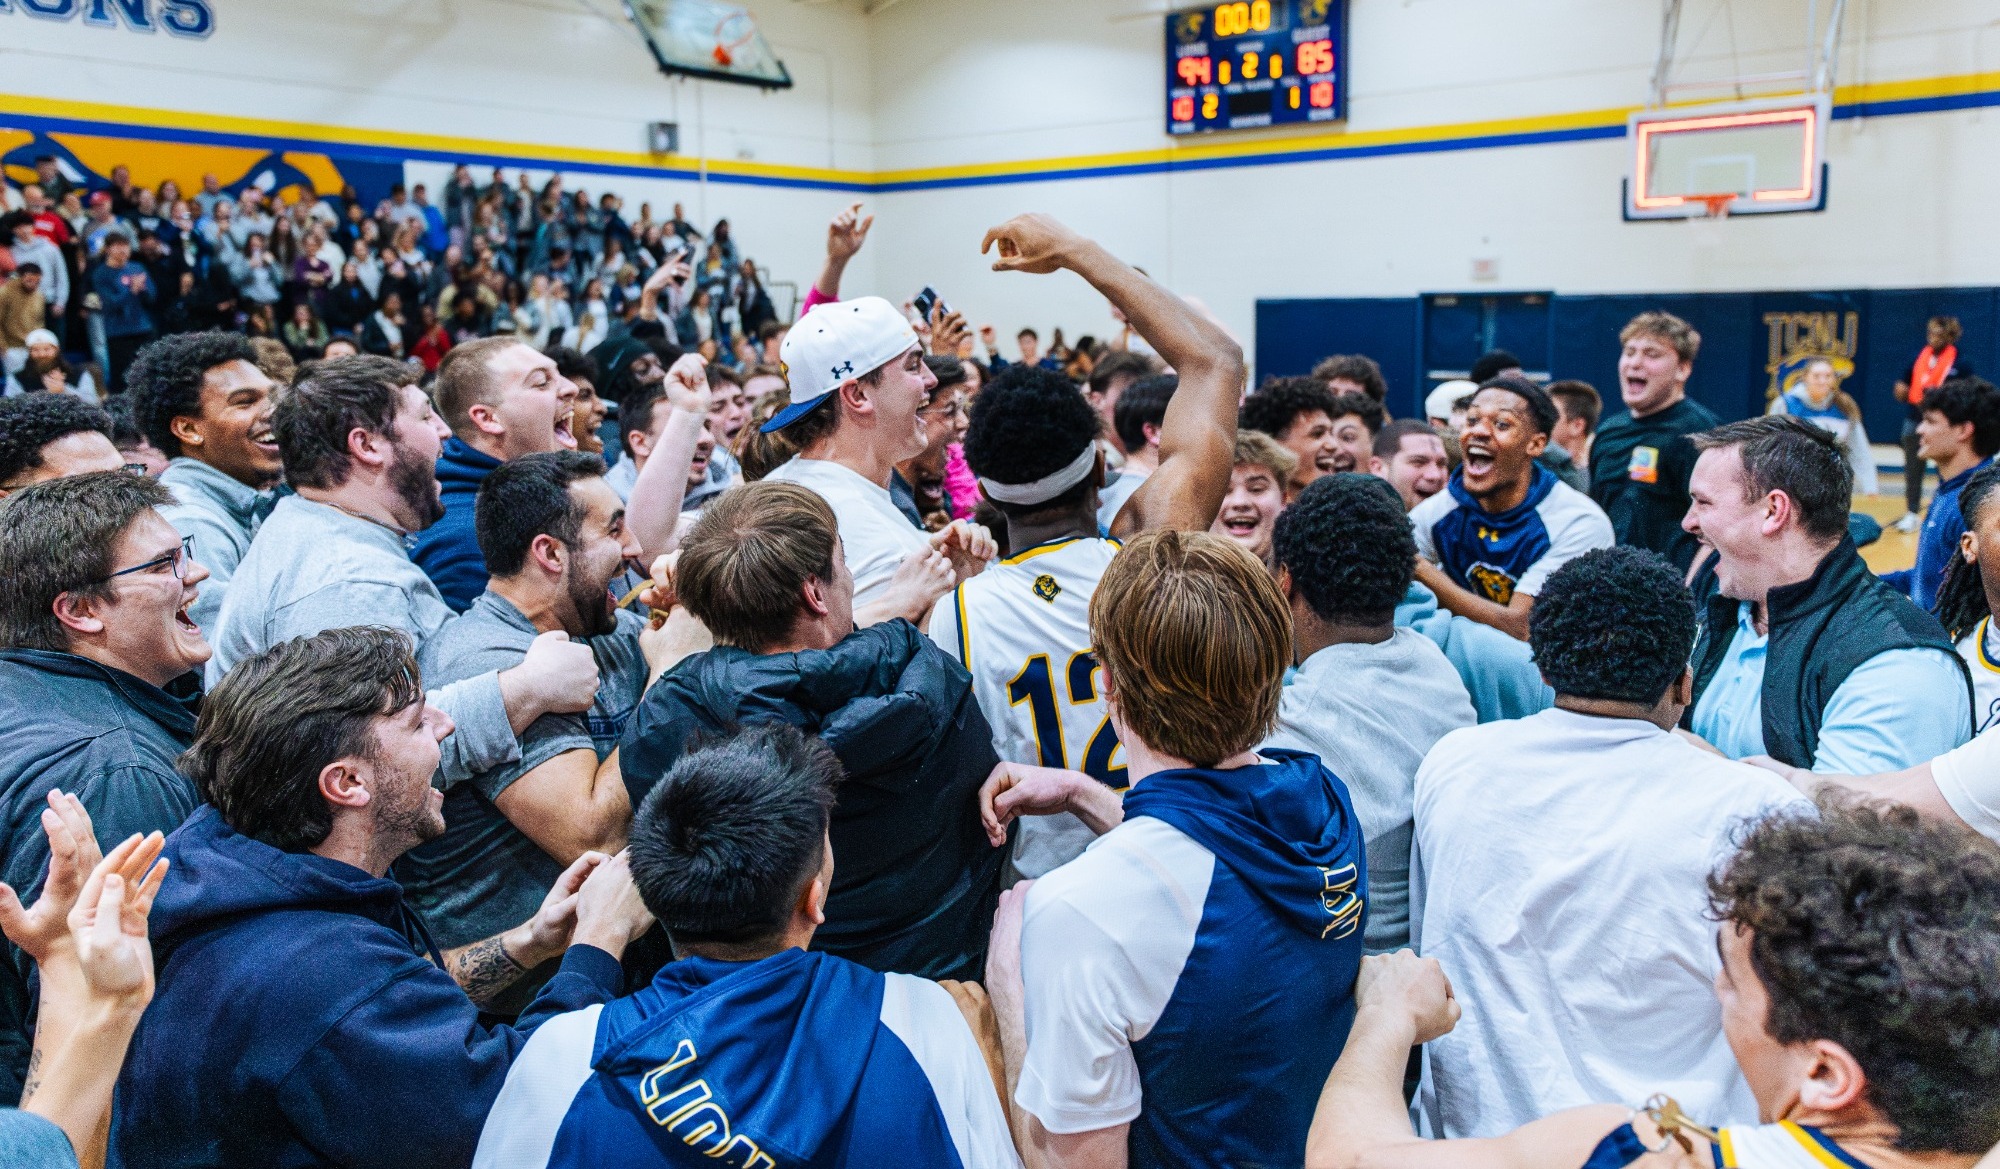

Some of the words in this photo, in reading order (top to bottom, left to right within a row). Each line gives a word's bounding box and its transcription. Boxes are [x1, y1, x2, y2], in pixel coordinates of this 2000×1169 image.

[1177, 56, 1212, 86] 94
[1241, 52, 1259, 78] 2
[1297, 39, 1334, 75] 85
[1202, 93, 1218, 119] 2
[1289, 85, 1300, 109] 1
[1006, 648, 1131, 792] 12
